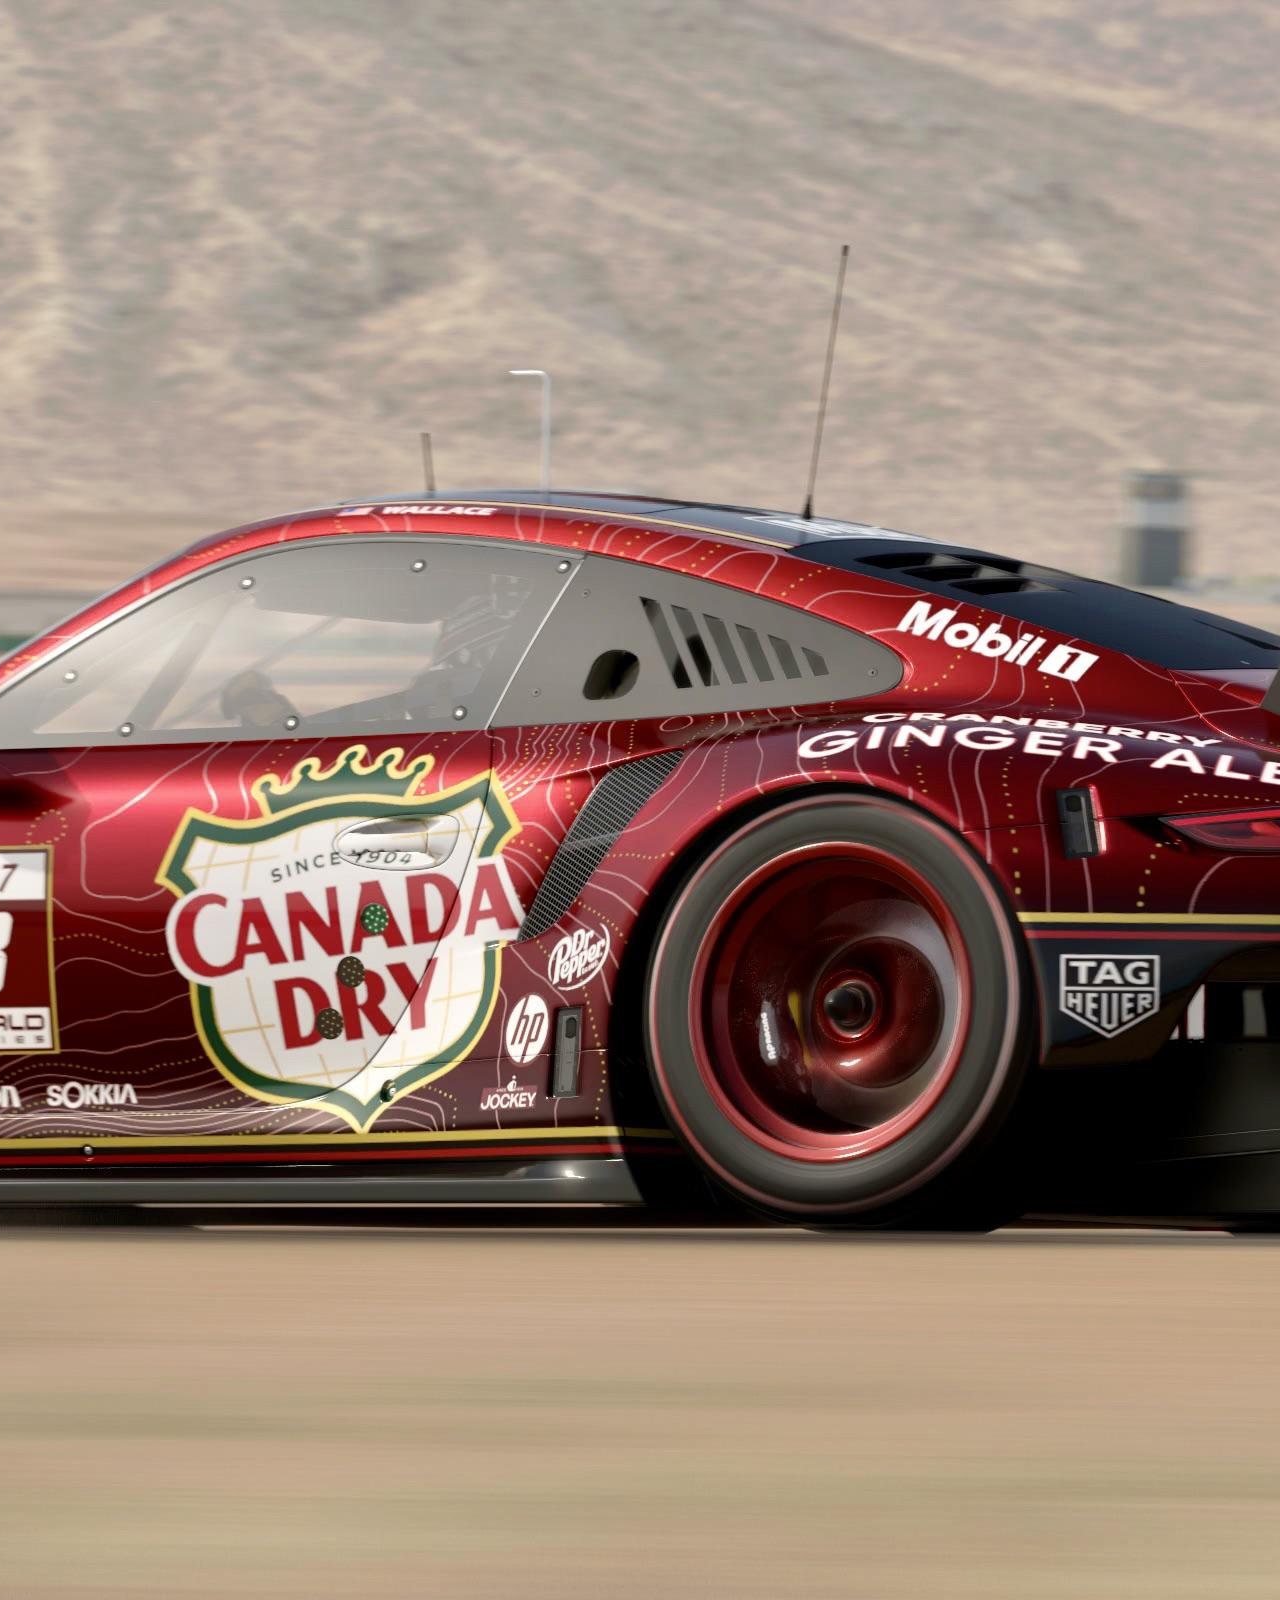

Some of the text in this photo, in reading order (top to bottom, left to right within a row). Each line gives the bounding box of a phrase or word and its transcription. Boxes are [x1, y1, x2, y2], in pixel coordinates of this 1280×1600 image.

[381, 505, 498, 516] WALLACE
[896, 600, 1047, 666] Mobil
[797, 724, 1122, 764] GINGER
[862, 711, 1223, 749] CRANBERRY
[270, 848, 413, 884] SINCE 1904
[174, 863, 520, 978] CANADA
[551, 936, 607, 985] Pepper
[570, 928, 595, 957] Dr
[1067, 960, 1151, 985] TAG
[273, 957, 439, 1050] DRY
[1066, 992, 1153, 1031] HEUER
[506, 995, 549, 1064] hp
[46, 1081, 139, 1109] SOKKIA
[480, 1091, 537, 1111] JOCKEY
